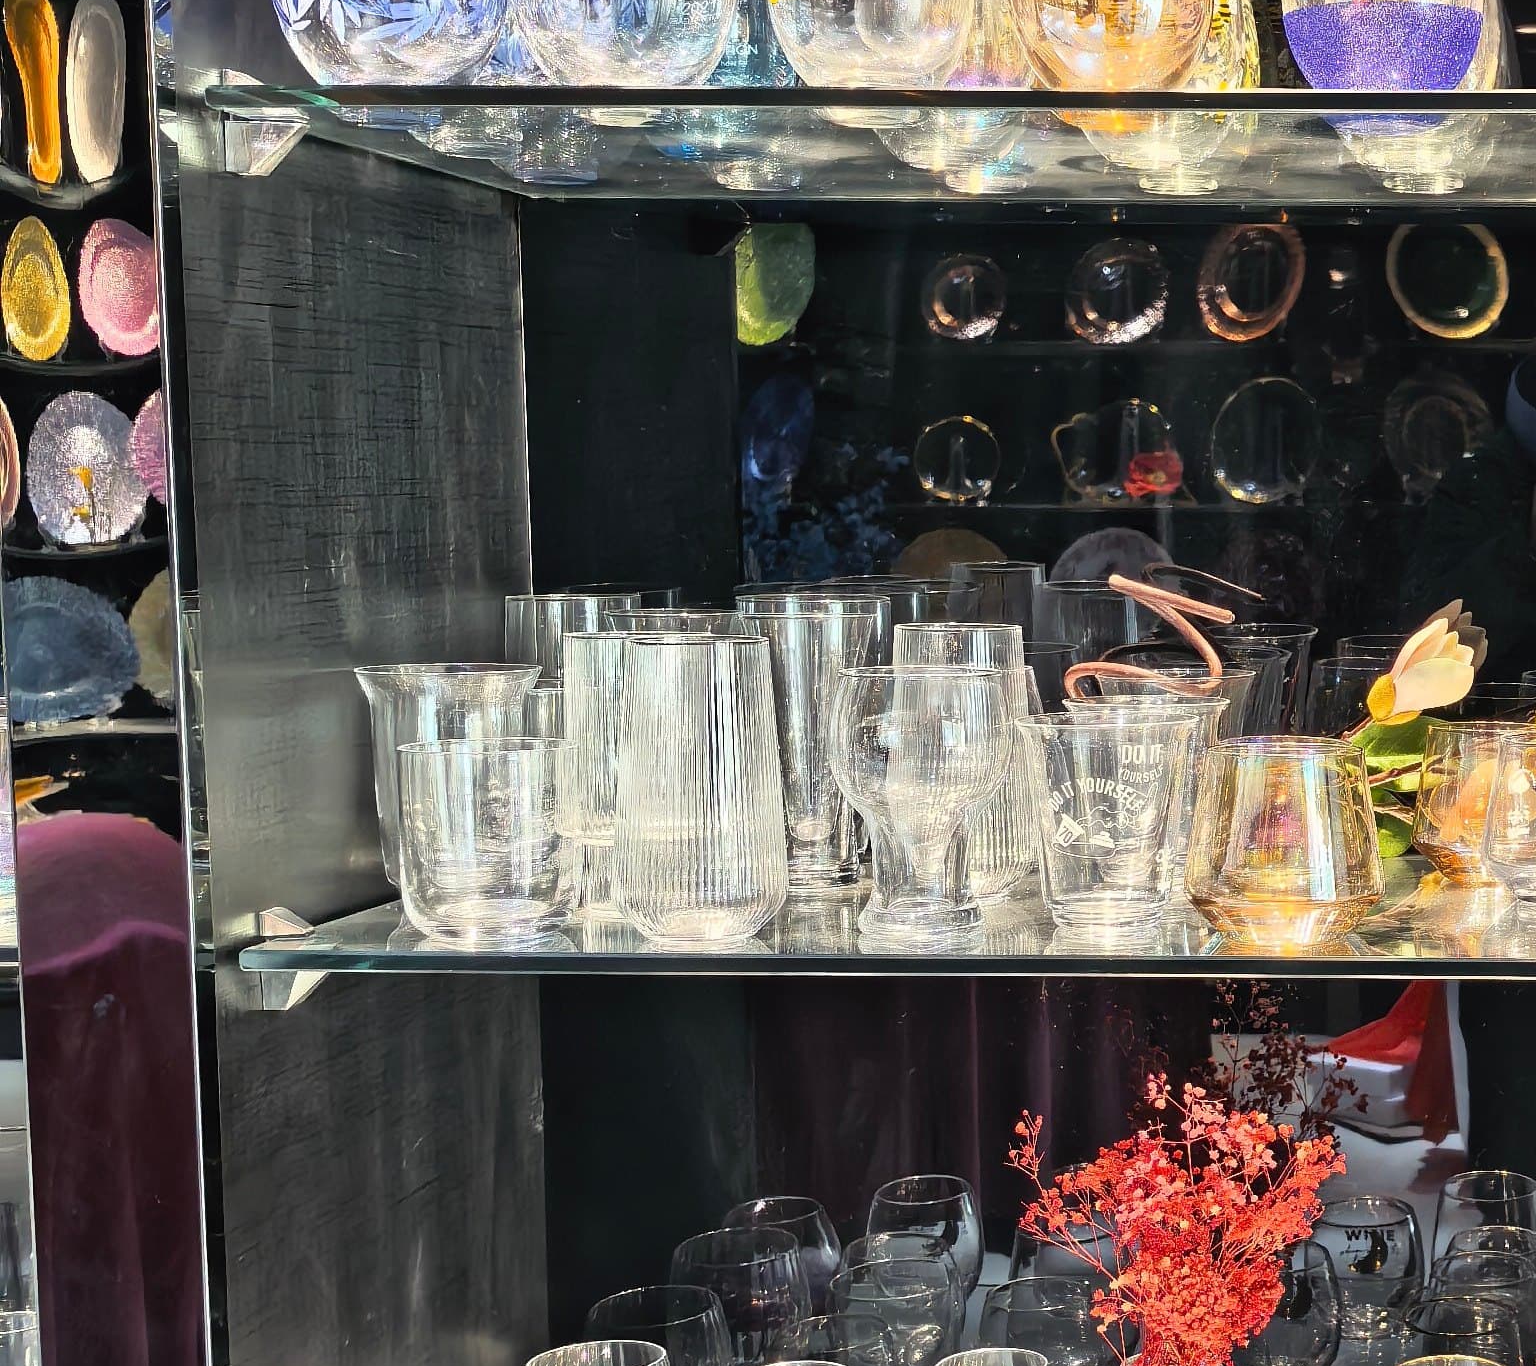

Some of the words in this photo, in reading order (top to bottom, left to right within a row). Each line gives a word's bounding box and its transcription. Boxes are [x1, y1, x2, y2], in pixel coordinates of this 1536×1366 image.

[1121, 744, 1145, 765] DO
[1119, 765, 1164, 784] YOURSELF
[1060, 781, 1075, 799] IT
